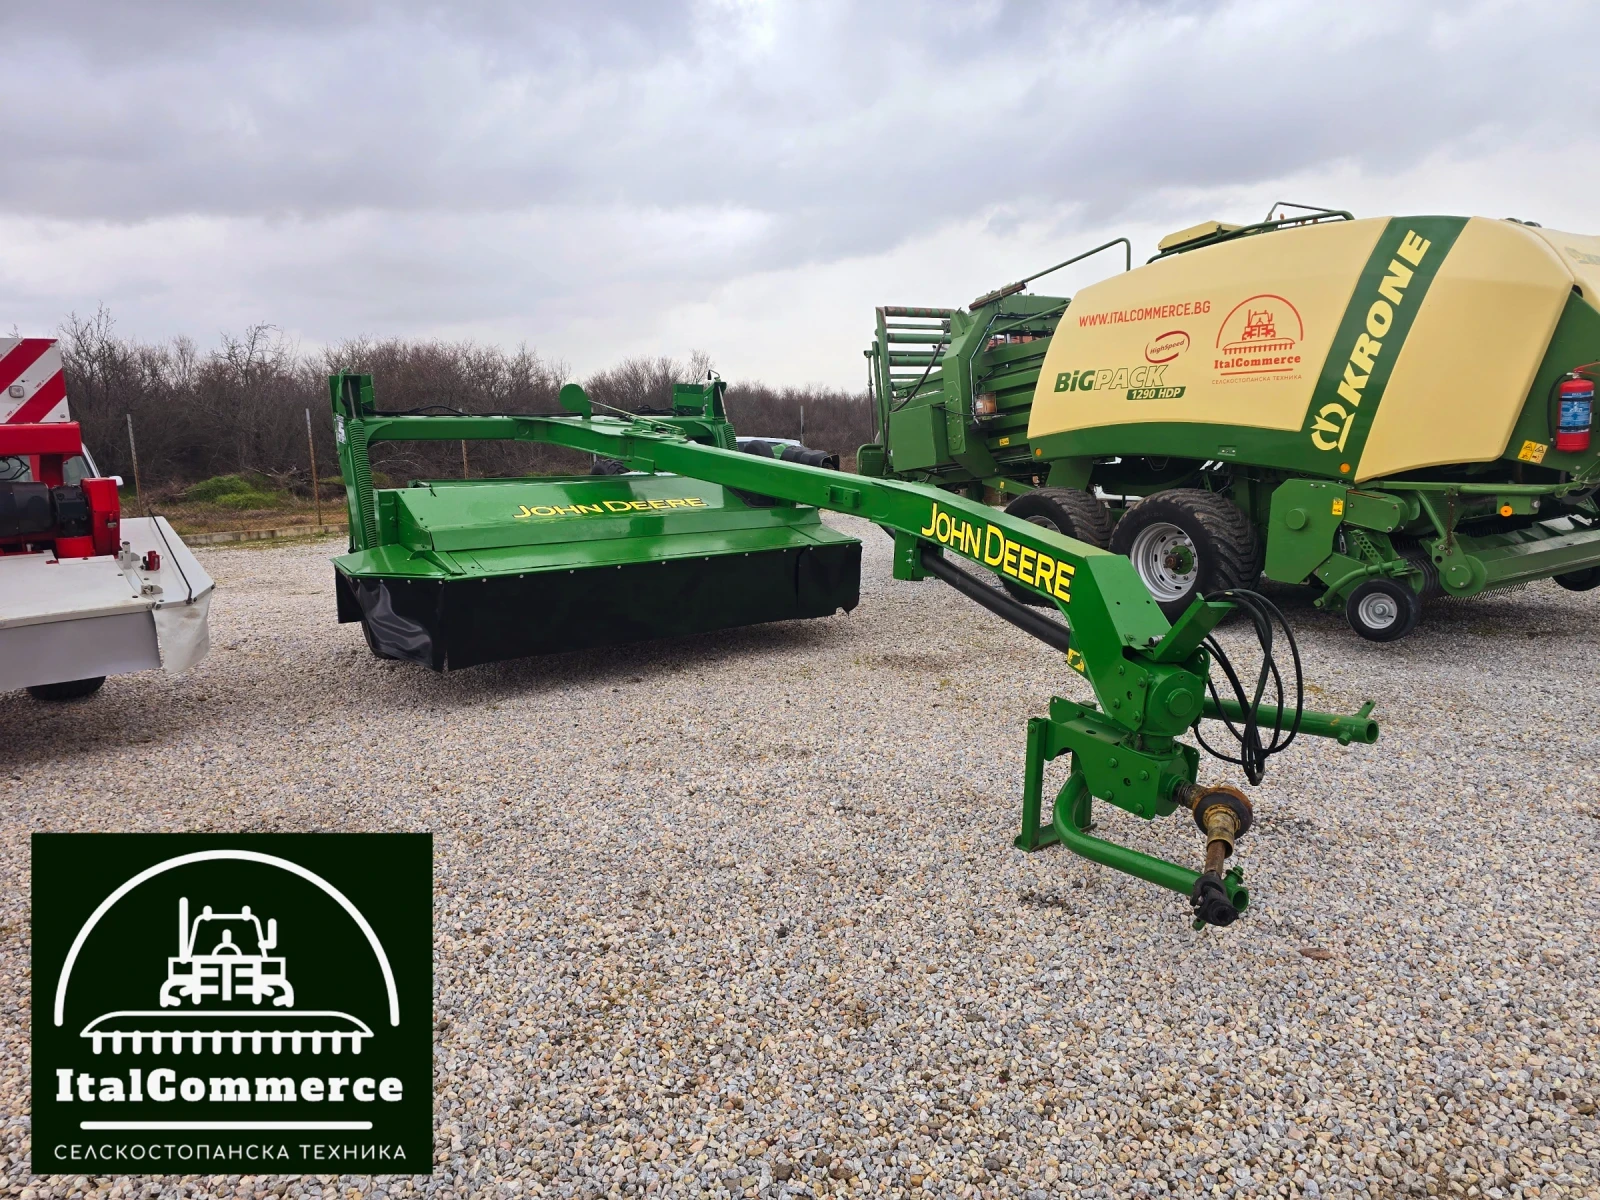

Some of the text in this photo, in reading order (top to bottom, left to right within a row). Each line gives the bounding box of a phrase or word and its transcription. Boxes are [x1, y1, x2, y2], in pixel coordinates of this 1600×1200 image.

[1079, 300, 1211, 327] WWW.ITALCOMMERCE.BG
[1337, 229, 1431, 407] KRONE
[1150, 339, 1185, 355] HighSpeed
[1214, 355, 1301, 369] ItalCommerce
[1212, 376, 1271, 385] СЕЛСКОСТОПАНСКА
[1132, 387, 1181, 399] 1290 HDP
[513, 497, 708, 518] JOHN DEERE
[921, 502, 1075, 603] JOHN DEERE
